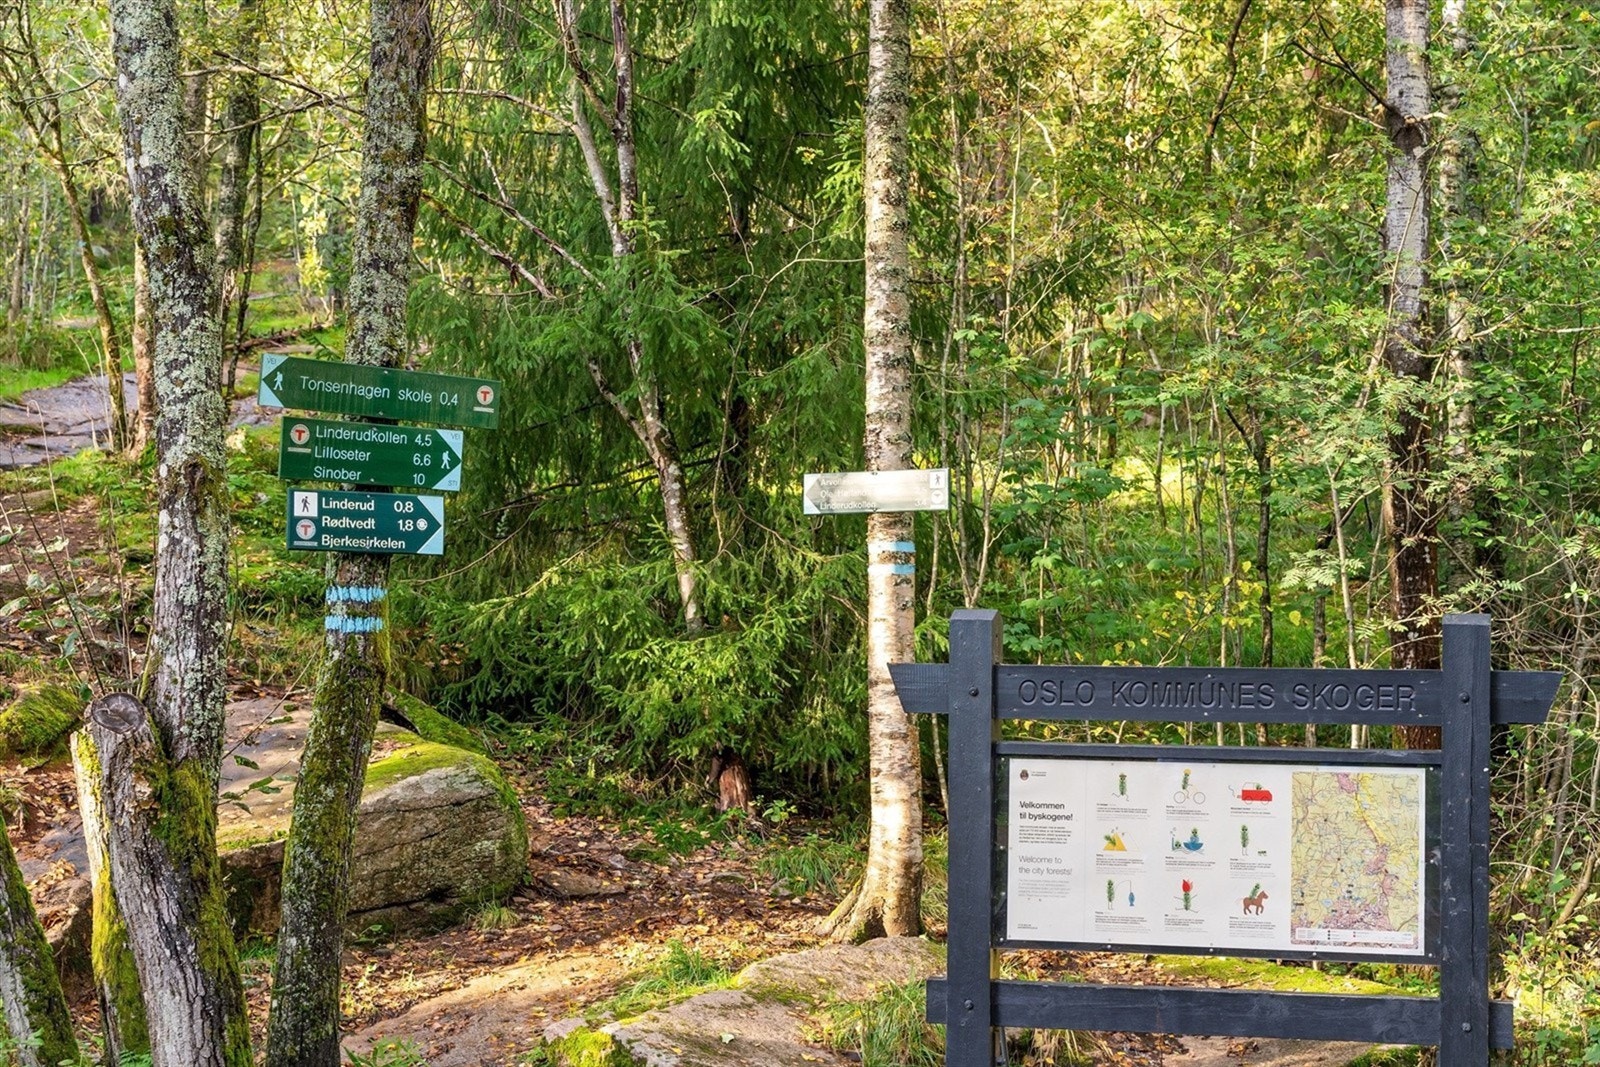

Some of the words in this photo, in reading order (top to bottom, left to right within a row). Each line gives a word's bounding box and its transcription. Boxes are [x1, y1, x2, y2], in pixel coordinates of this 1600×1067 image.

[300, 375, 390, 399] Tonsenhagen
[398, 387, 432, 404] skole
[439, 392, 458, 406] 0,4
[315, 425, 407, 445] Linderudkollen
[414, 433, 432, 447] 4,5
[314, 445, 371, 462] Lilloseter
[413, 453, 431, 467] 6,6
[313, 465, 362, 481] Sinober
[413, 473, 425, 485] 10
[321, 497, 375, 511] Linderud
[393, 500, 414, 513] 0,8
[321, 516, 376, 530] Rødtvedt
[397, 519, 414, 533] 1,8
[321, 534, 406, 549] Bjerkesirkelen
[1018, 679, 1095, 706] OSLO
[1112, 681, 1277, 709] KOMMUNES
[1292, 683, 1417, 712] SKOGER
[1019, 801, 1065, 810] Velkommen
[1028, 813, 1073, 822] byskogene!
[1018, 855, 1053, 864] Welcome
[1018, 866, 1030, 874] the
[1032, 867, 1045, 876] city
[1046, 867, 1072, 876] forests!
